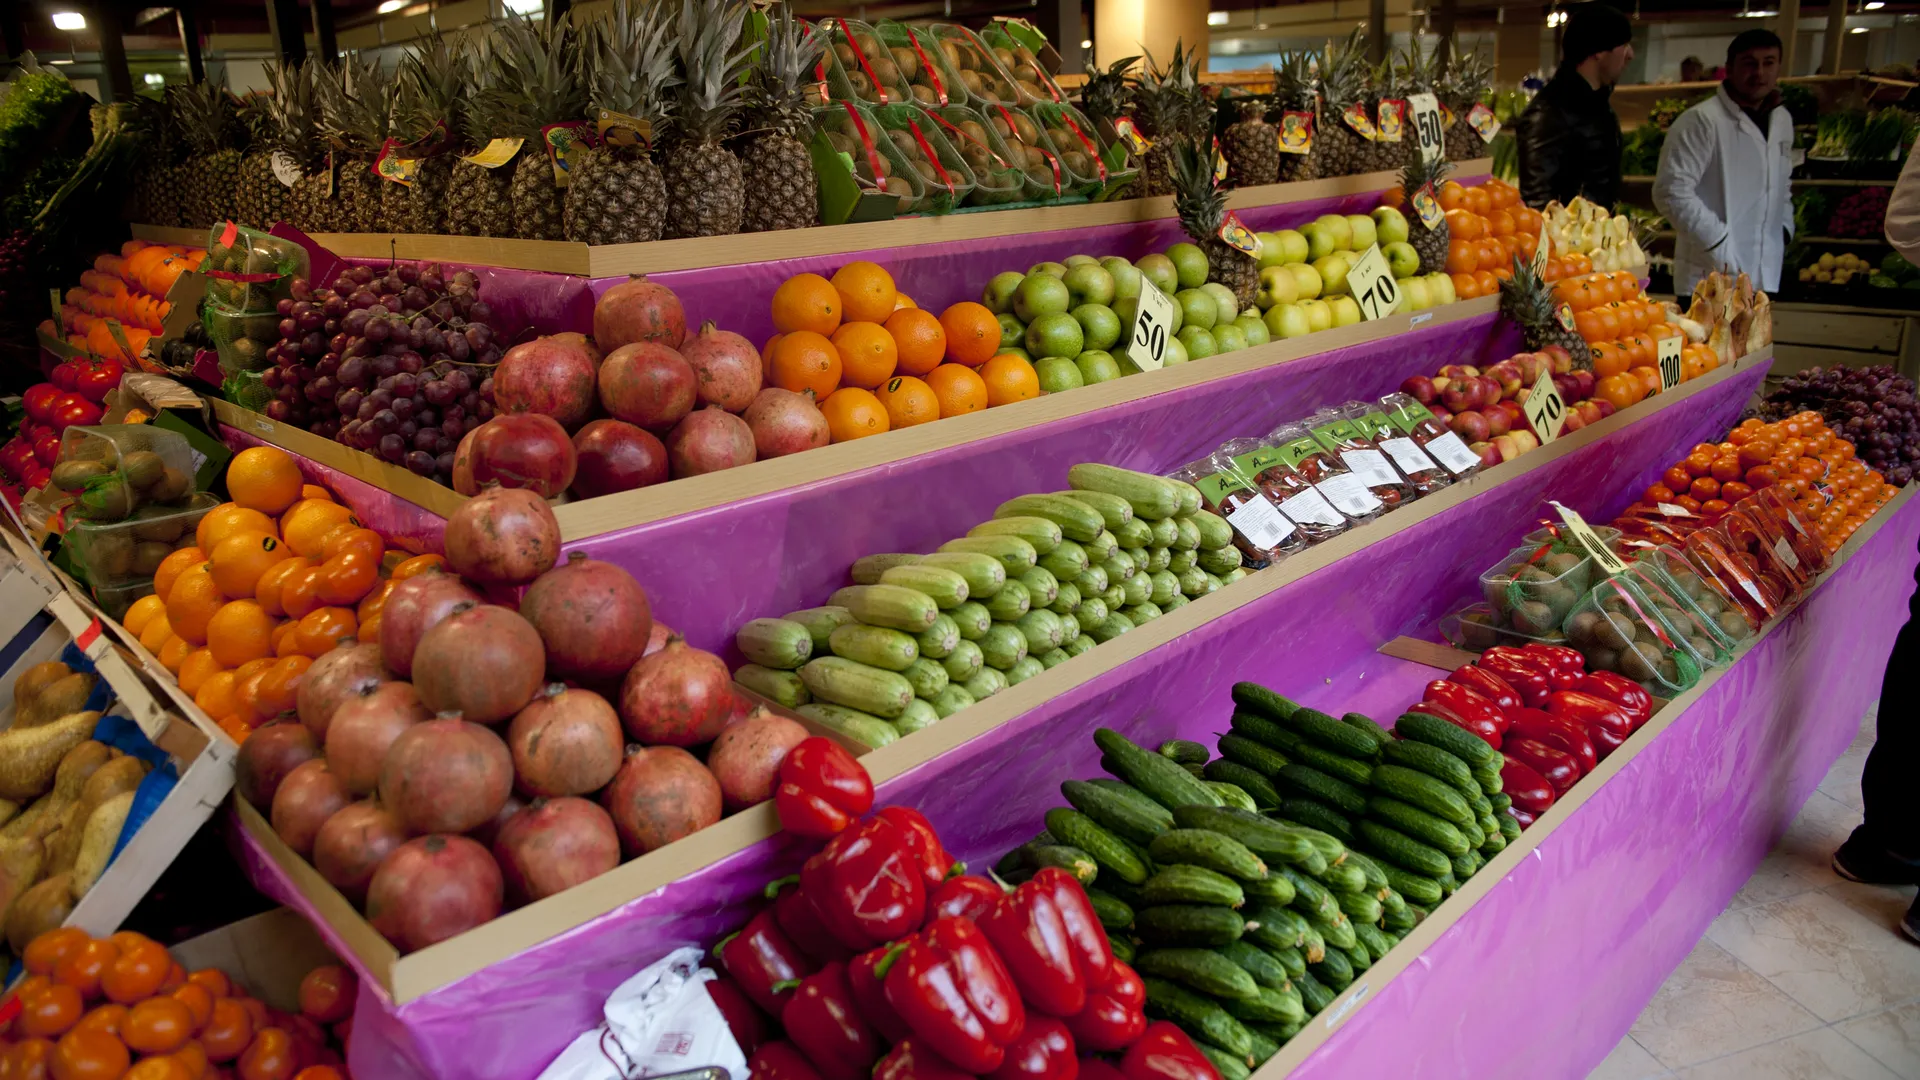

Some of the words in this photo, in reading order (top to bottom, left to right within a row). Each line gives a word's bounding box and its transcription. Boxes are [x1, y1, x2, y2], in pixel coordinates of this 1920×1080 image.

[1416, 109, 1442, 148] 50
[1361, 274, 1396, 319] 70
[1136, 309, 1165, 362] 50
[1659, 353, 1680, 390] 100
[1534, 393, 1561, 438] 70
